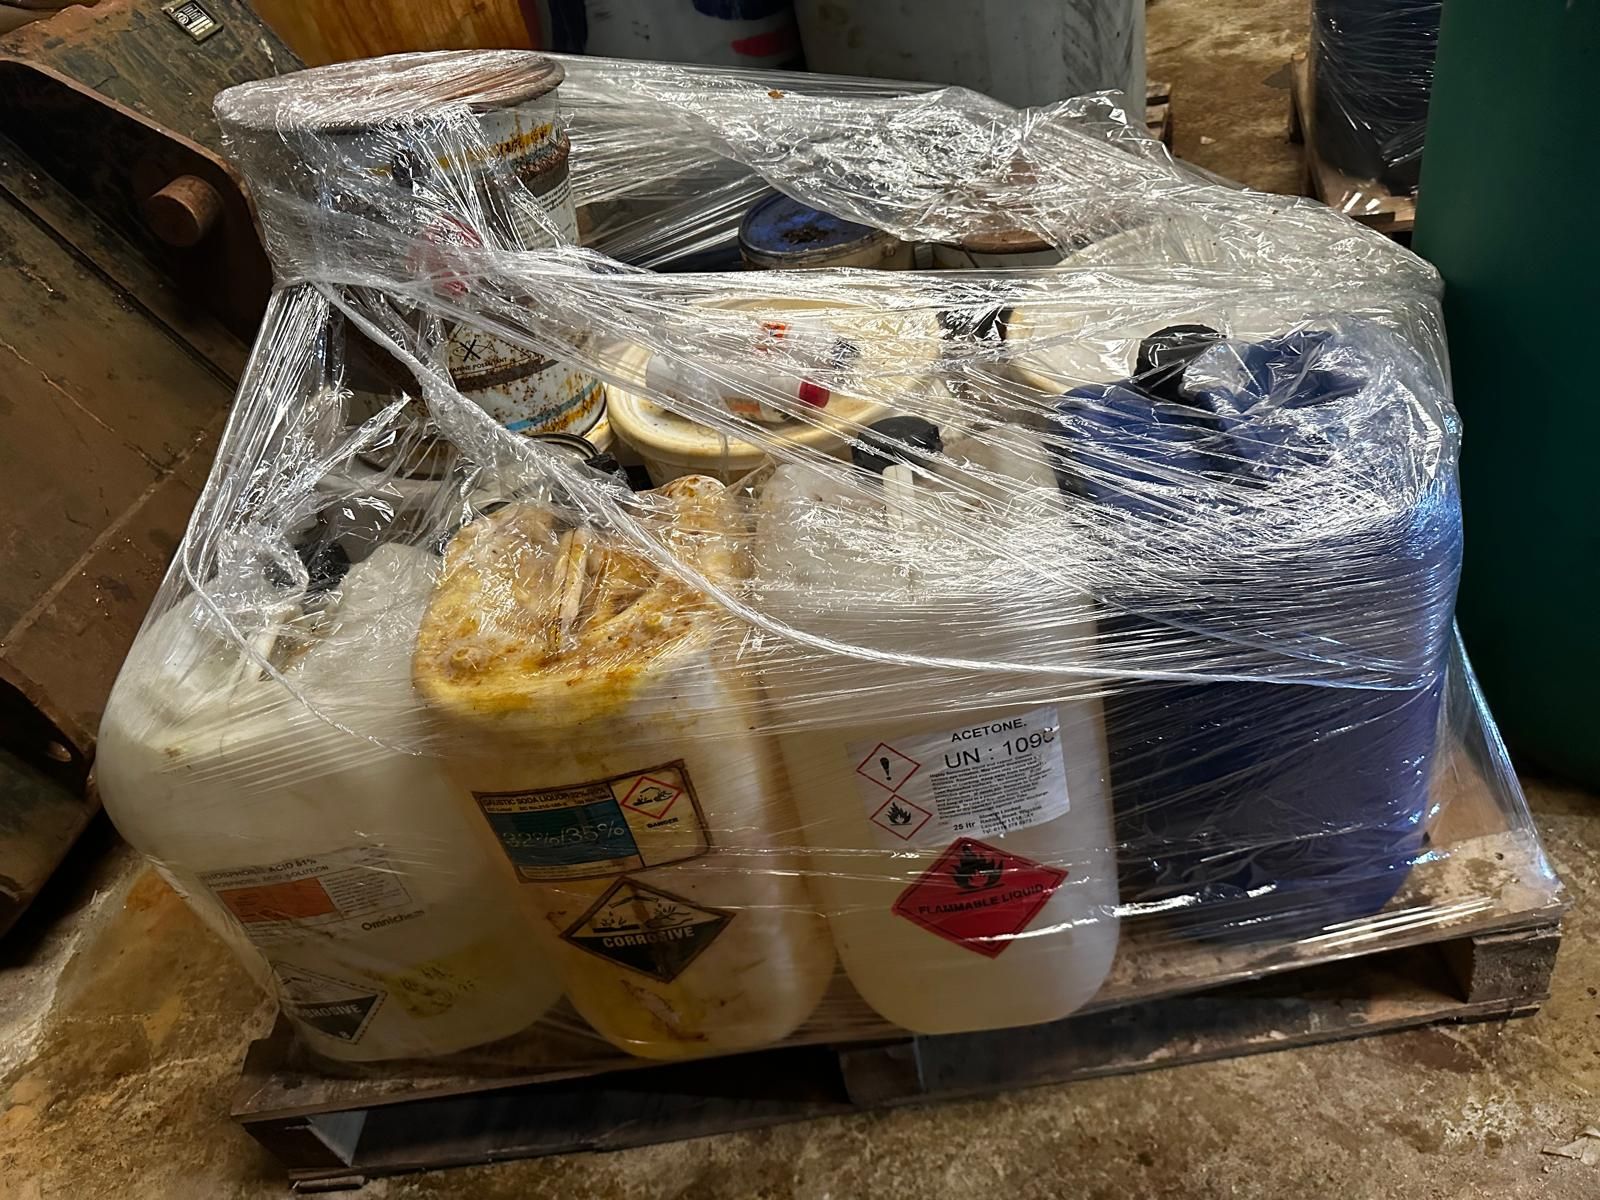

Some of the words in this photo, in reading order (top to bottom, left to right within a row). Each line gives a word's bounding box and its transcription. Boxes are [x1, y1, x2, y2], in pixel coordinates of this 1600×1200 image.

[951, 718, 1027, 742] ACETONE.
[944, 748, 981, 769] UN
[539, 792, 569, 803] LIQUOR
[646, 817, 679, 829] DANGER
[268, 862, 294, 873] ACID
[918, 895, 1001, 915] FLAMMABLE
[1002, 883, 1045, 903] LIQUID
[602, 926, 695, 948] CORROSIVE
